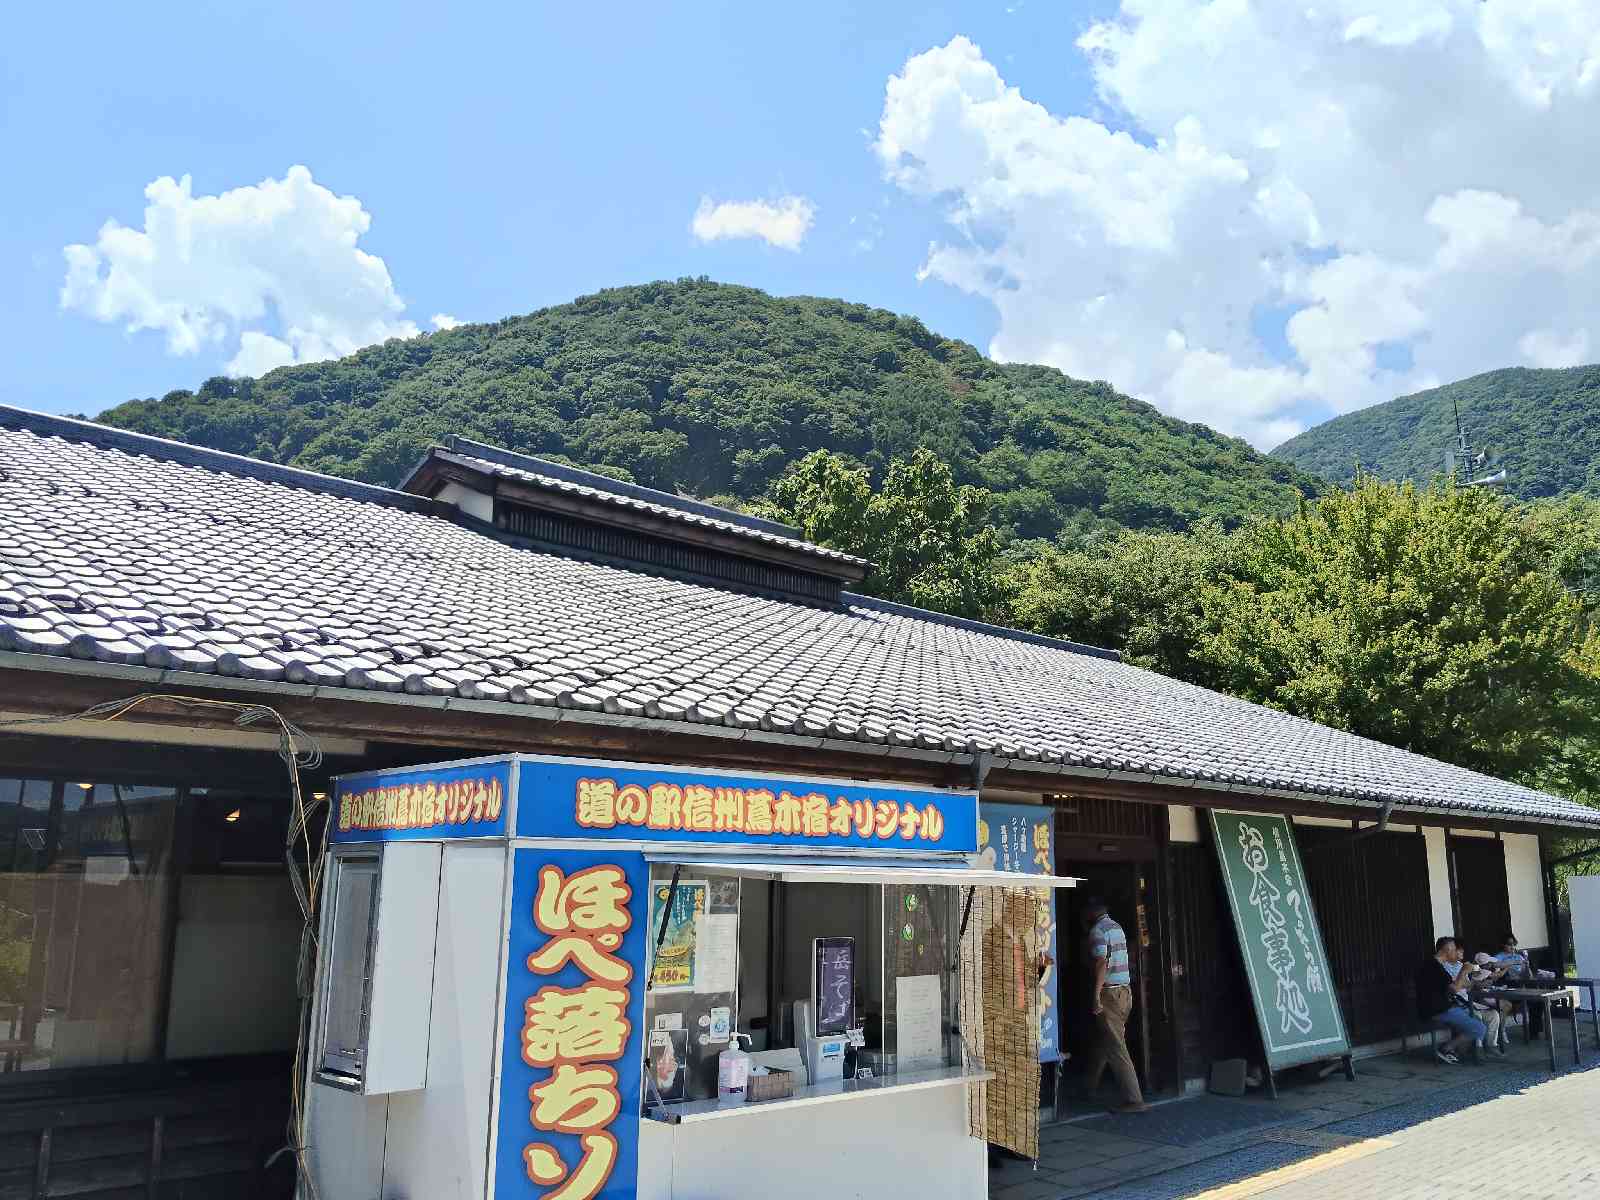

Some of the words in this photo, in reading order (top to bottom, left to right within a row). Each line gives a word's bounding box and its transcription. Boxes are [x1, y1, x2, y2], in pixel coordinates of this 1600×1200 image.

[339, 779, 502, 831] 道の駅信州蔦木宿オリジナル
[577, 778, 943, 841] 道の駅信州蔦木宿オリジナル
[1238, 821, 1312, 1034] お食事処
